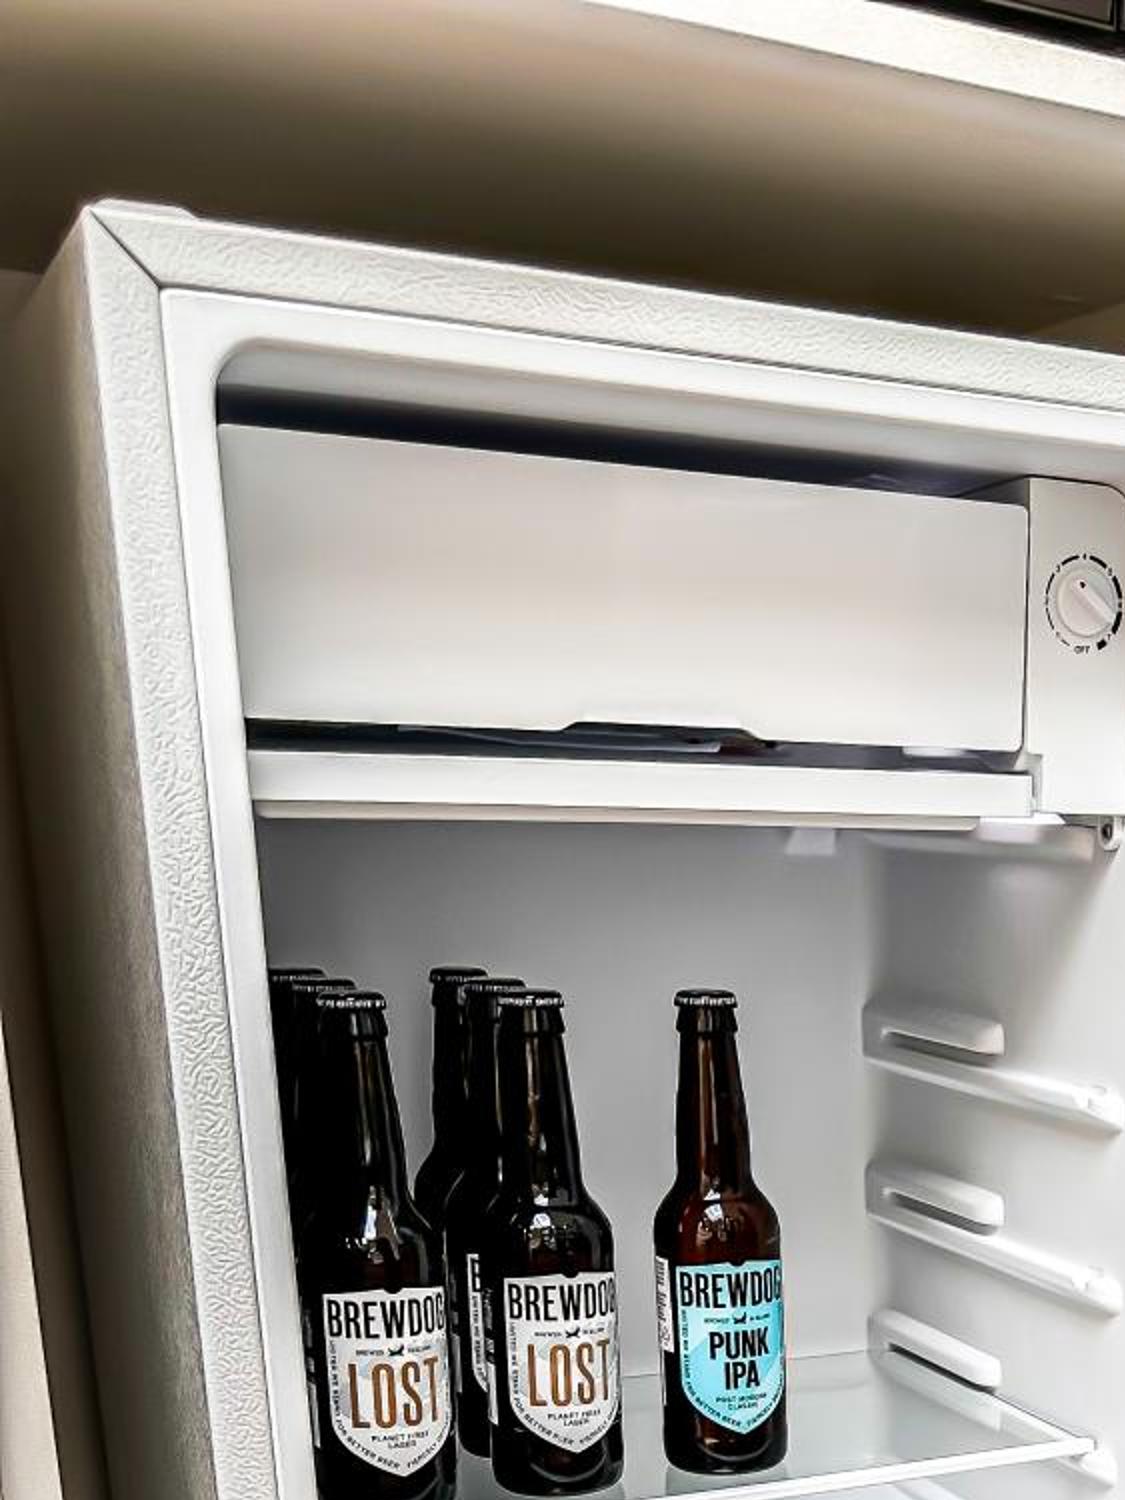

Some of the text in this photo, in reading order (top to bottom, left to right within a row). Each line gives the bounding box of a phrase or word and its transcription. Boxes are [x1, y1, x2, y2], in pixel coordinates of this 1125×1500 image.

[679, 1265, 781, 1309] BREWDOG
[326, 1292, 445, 1339] BREWDOG
[709, 1326, 770, 1360] PUNK
[347, 1355, 439, 1429] LOST
[527, 1338, 610, 1407] LOST
[724, 1361, 760, 1390] IPA
